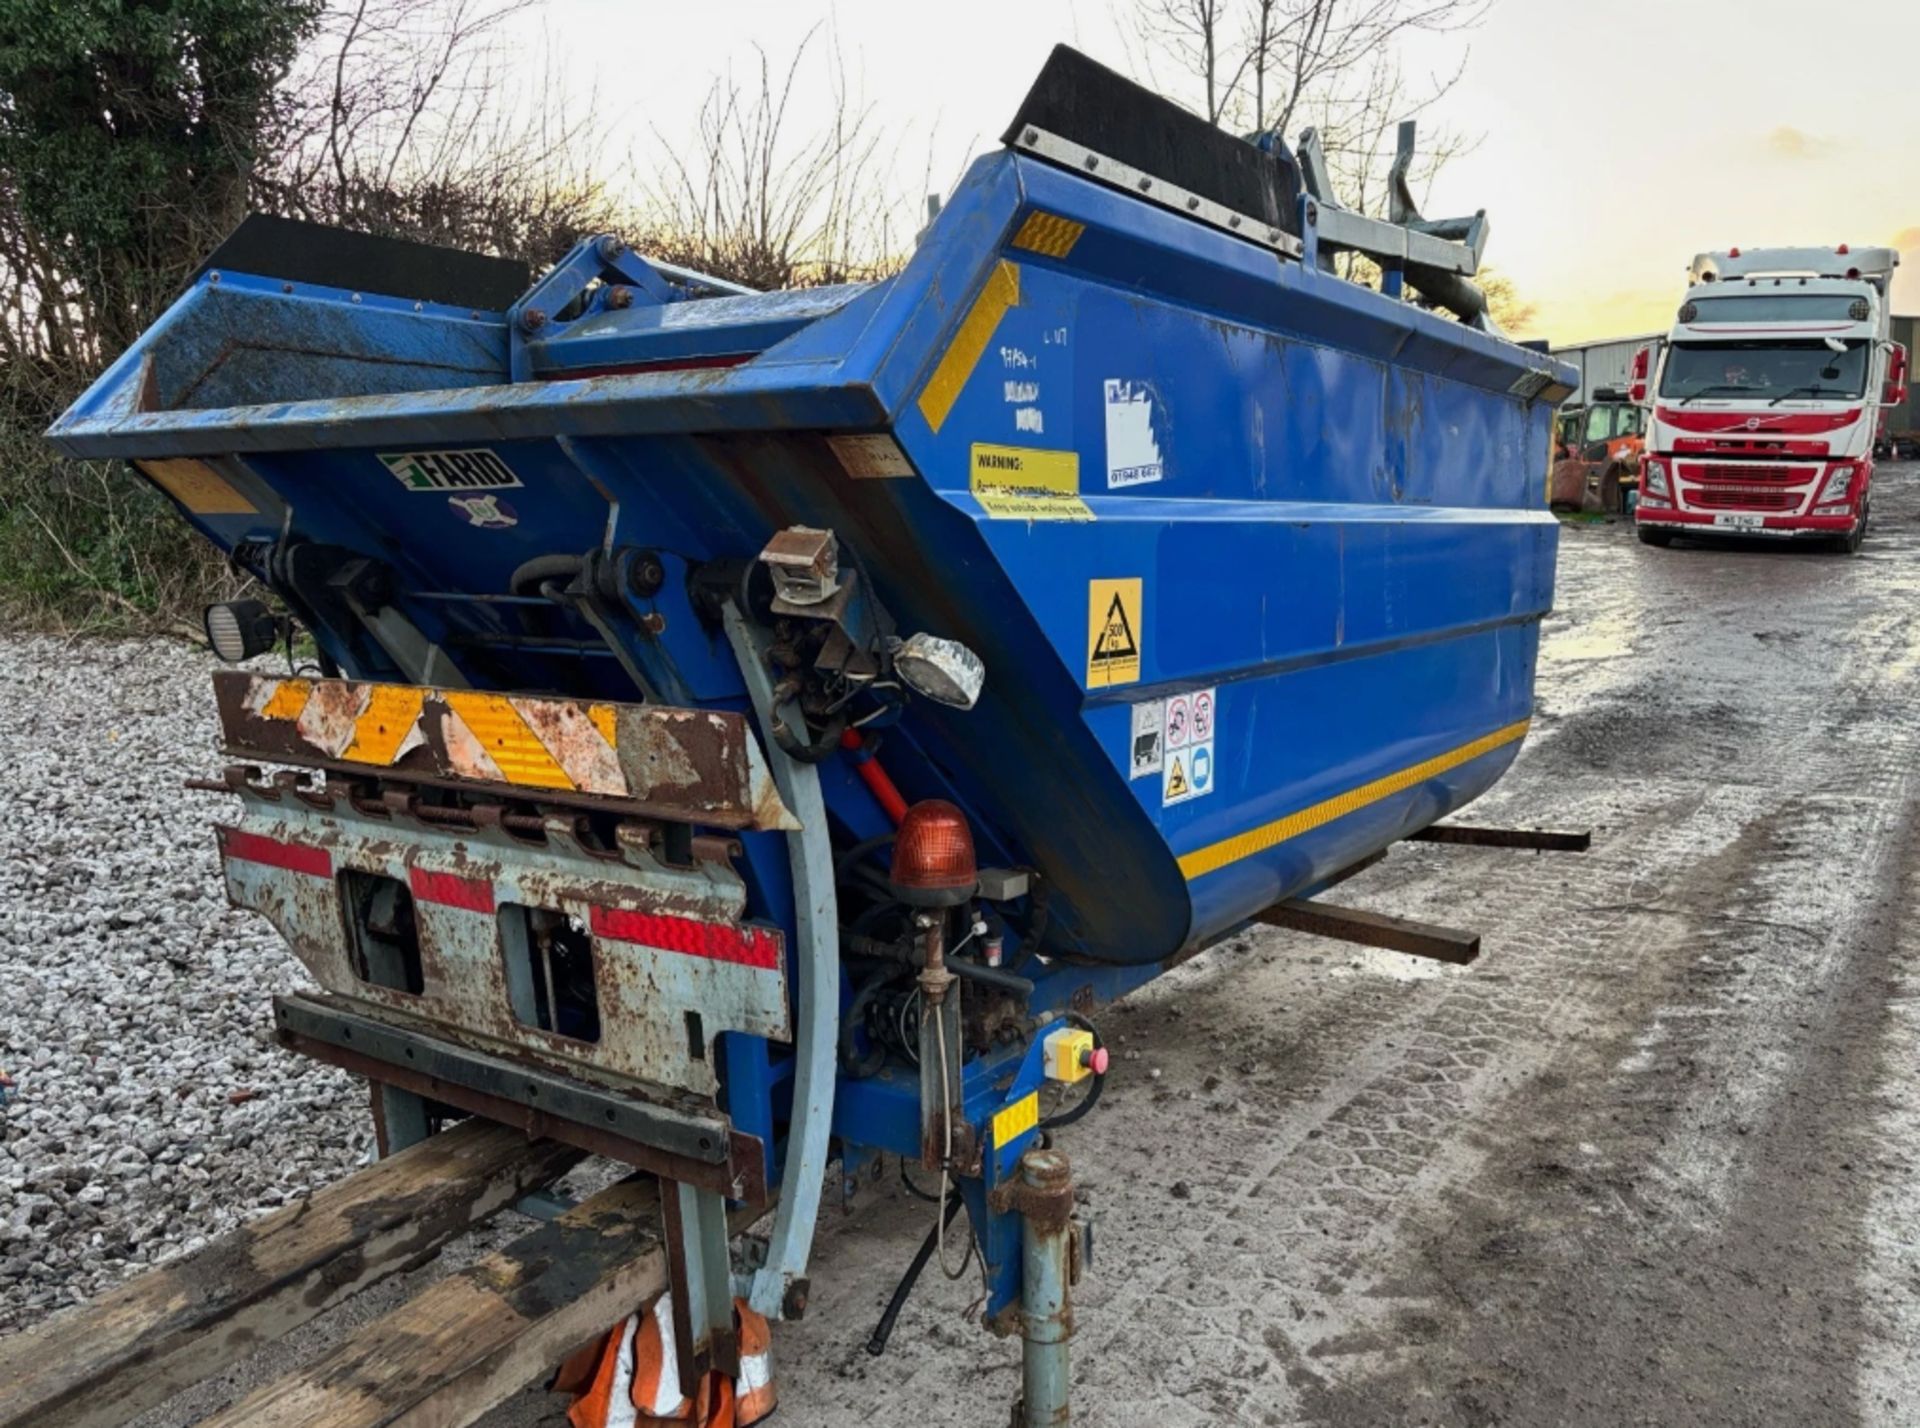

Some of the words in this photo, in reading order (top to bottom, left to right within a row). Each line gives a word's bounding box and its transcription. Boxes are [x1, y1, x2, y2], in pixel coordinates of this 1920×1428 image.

[411, 452, 517, 488] FARID
[977, 454, 1024, 471] WARNING:
[1108, 624, 1123, 637] 500
